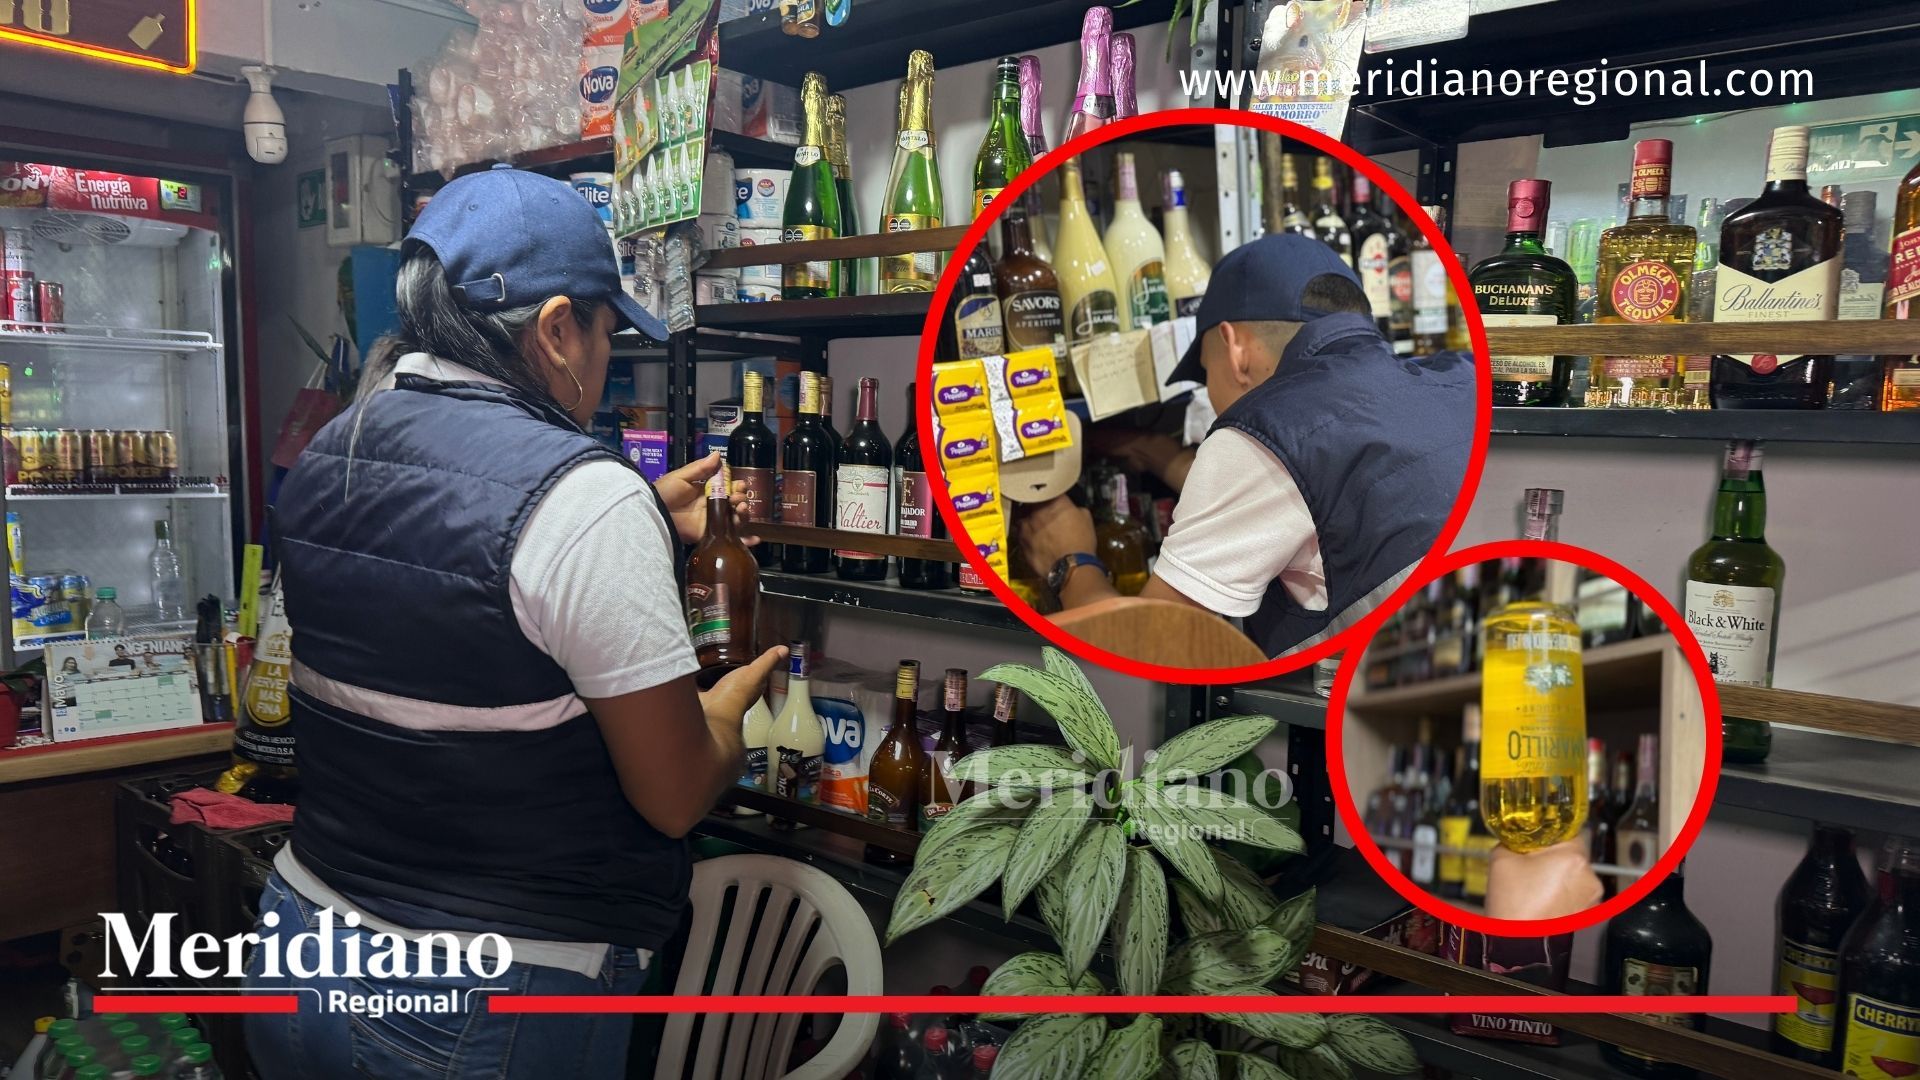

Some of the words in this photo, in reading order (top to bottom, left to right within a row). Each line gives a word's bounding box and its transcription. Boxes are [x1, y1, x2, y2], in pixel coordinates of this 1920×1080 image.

[582, 75, 614, 95] Nova
[1638, 166, 1665, 177] OLMECA
[73, 171, 132, 196] Energía
[1620, 264, 1675, 287] OLMECA
[1474, 284, 1555, 295] BUCHANAN'S
[1618, 297, 1674, 321] TEQUILA
[1748, 310, 1791, 319] FINEST
[838, 501, 883, 530] Valtier
[1688, 609, 1714, 627] Black
[1715, 615, 1727, 629] &
[1727, 615, 1767, 631] White
[267, 665, 282, 677] LA
[54, 674, 67, 708] Mayo
[256, 702, 282, 716] FINA
[1471, 1013, 1507, 1031] VINO
[1509, 1018, 1553, 1037] TINTO
